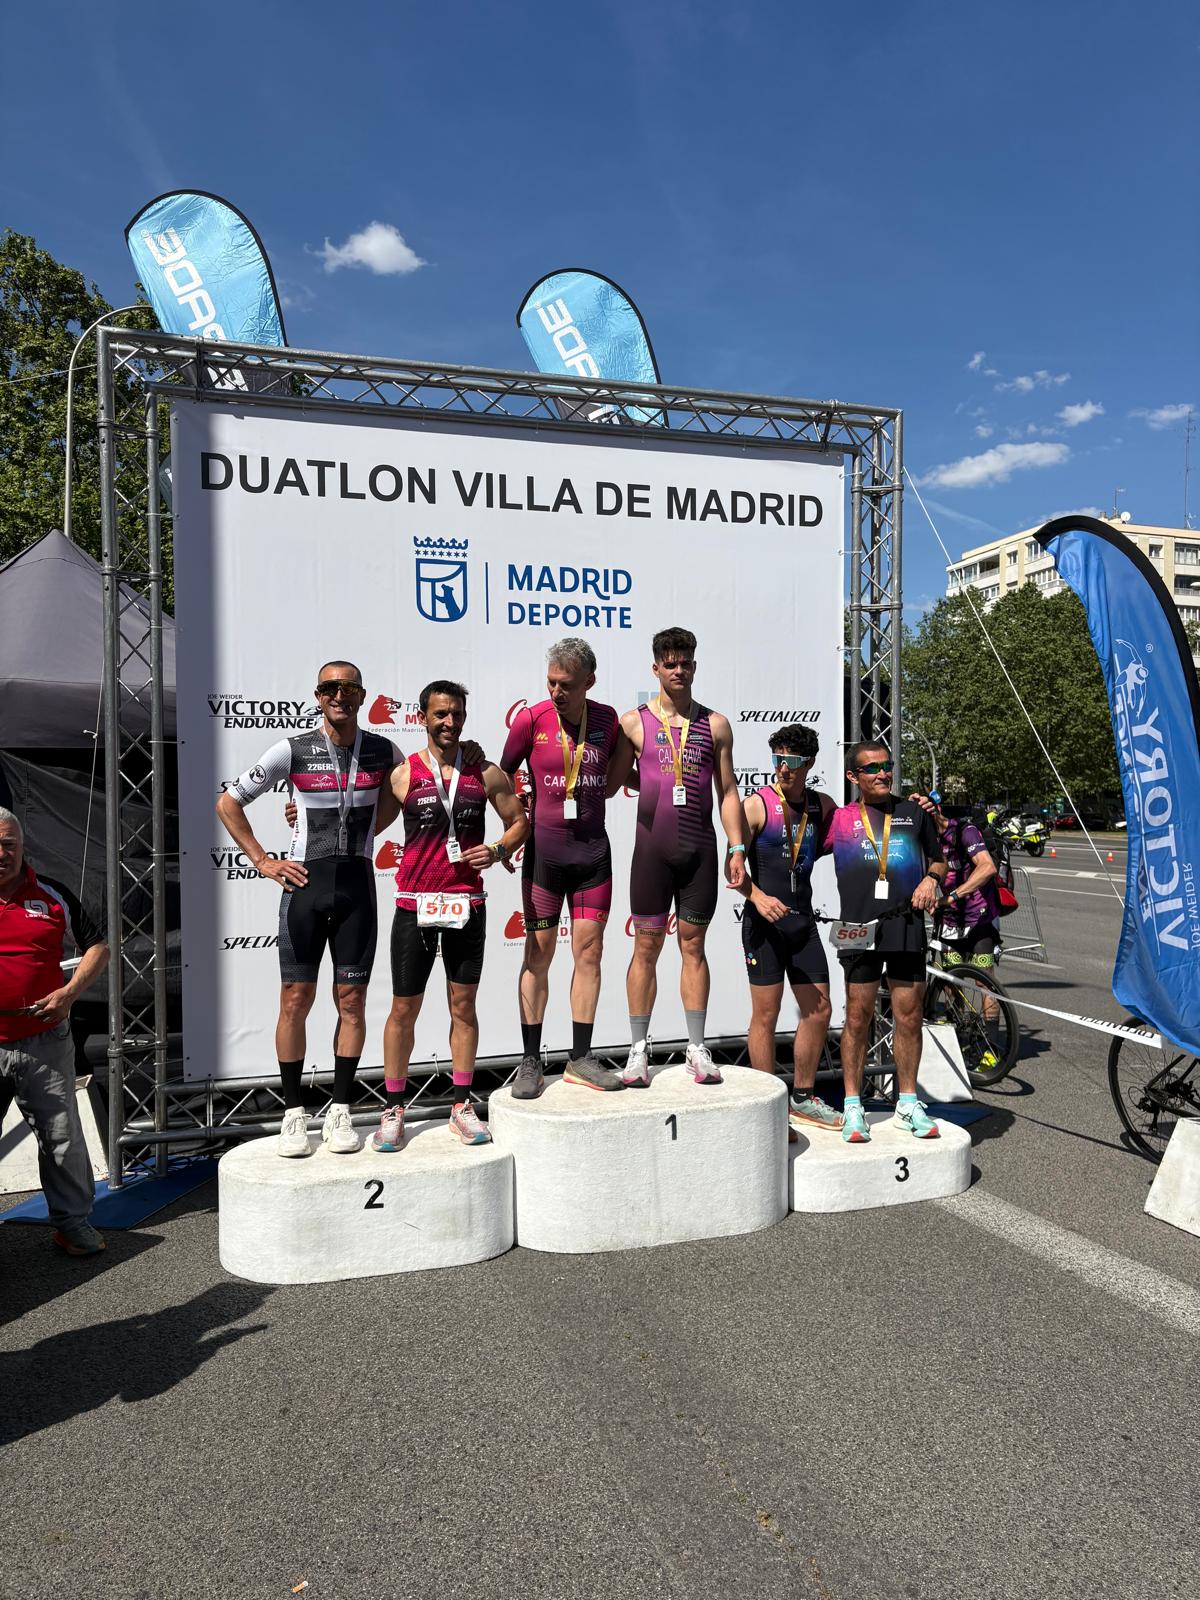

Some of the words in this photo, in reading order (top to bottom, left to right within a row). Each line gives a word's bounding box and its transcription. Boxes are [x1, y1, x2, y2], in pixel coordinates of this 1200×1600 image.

[201, 452, 436, 504] DUATLON
[452, 470, 583, 514] VILLA
[596, 481, 651, 518] DE
[666, 486, 823, 527] MADRID
[508, 564, 632, 600] MADRID
[508, 602, 632, 629] DEPORTE
[208, 700, 305, 716] VICTORY
[224, 717, 314, 729] ENDURANCE
[737, 711, 821, 723] SPECIALIZED
[735, 773, 777, 786] VICT
[426, 902, 463, 916] 570
[836, 927, 868, 940] 566
[219, 935, 279, 950] SPECIA
[665, 1114, 677, 1140] 1
[895, 1156, 909, 1182] 3
[364, 1179, 384, 1209] 2
